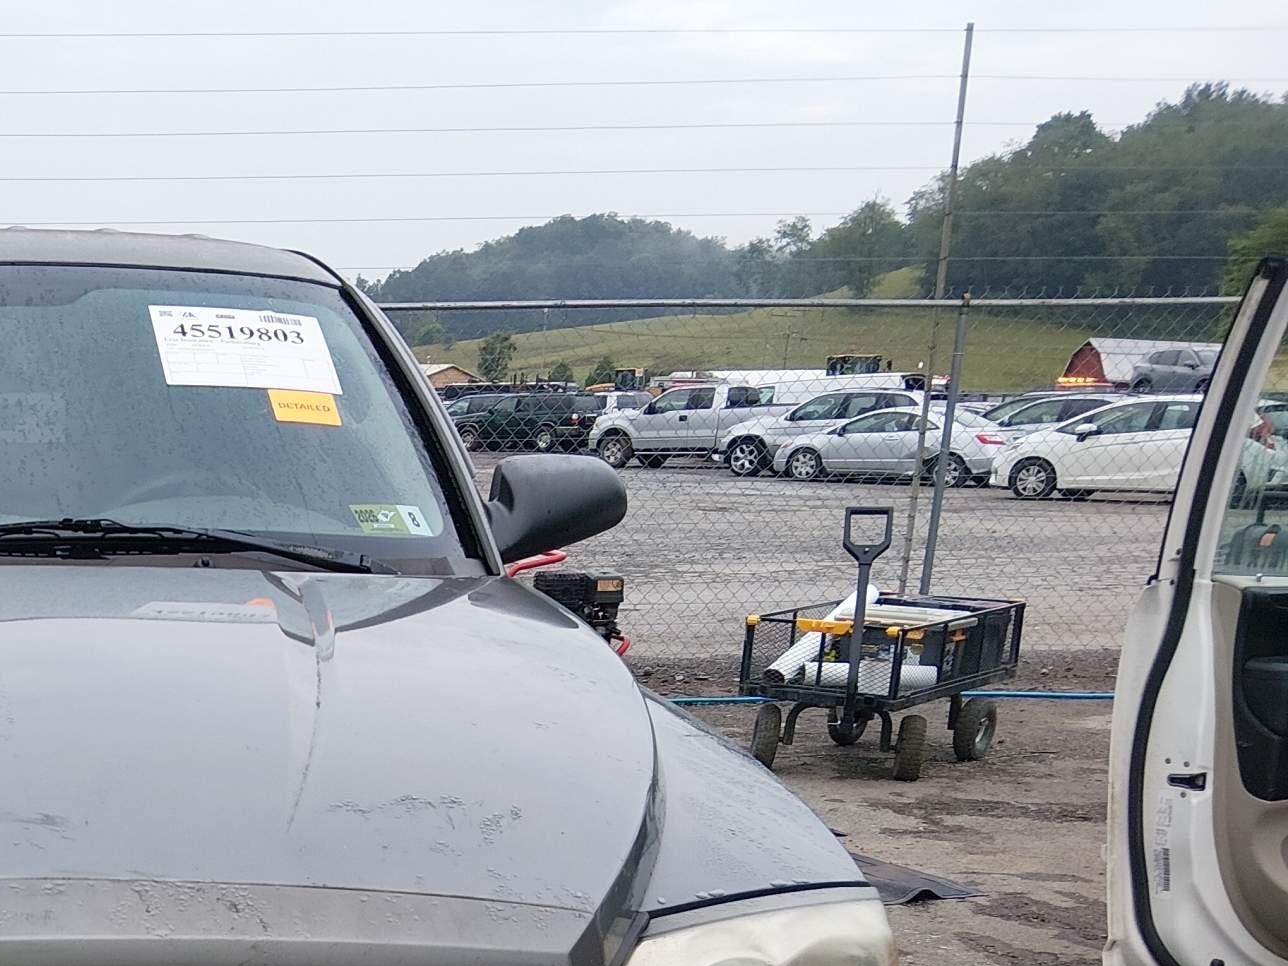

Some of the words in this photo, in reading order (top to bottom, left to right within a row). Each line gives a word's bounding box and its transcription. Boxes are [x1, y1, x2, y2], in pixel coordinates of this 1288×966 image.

[173, 323, 305, 345] 45519803
[278, 402, 331, 412] DETAILED
[407, 511, 421, 528] 8
